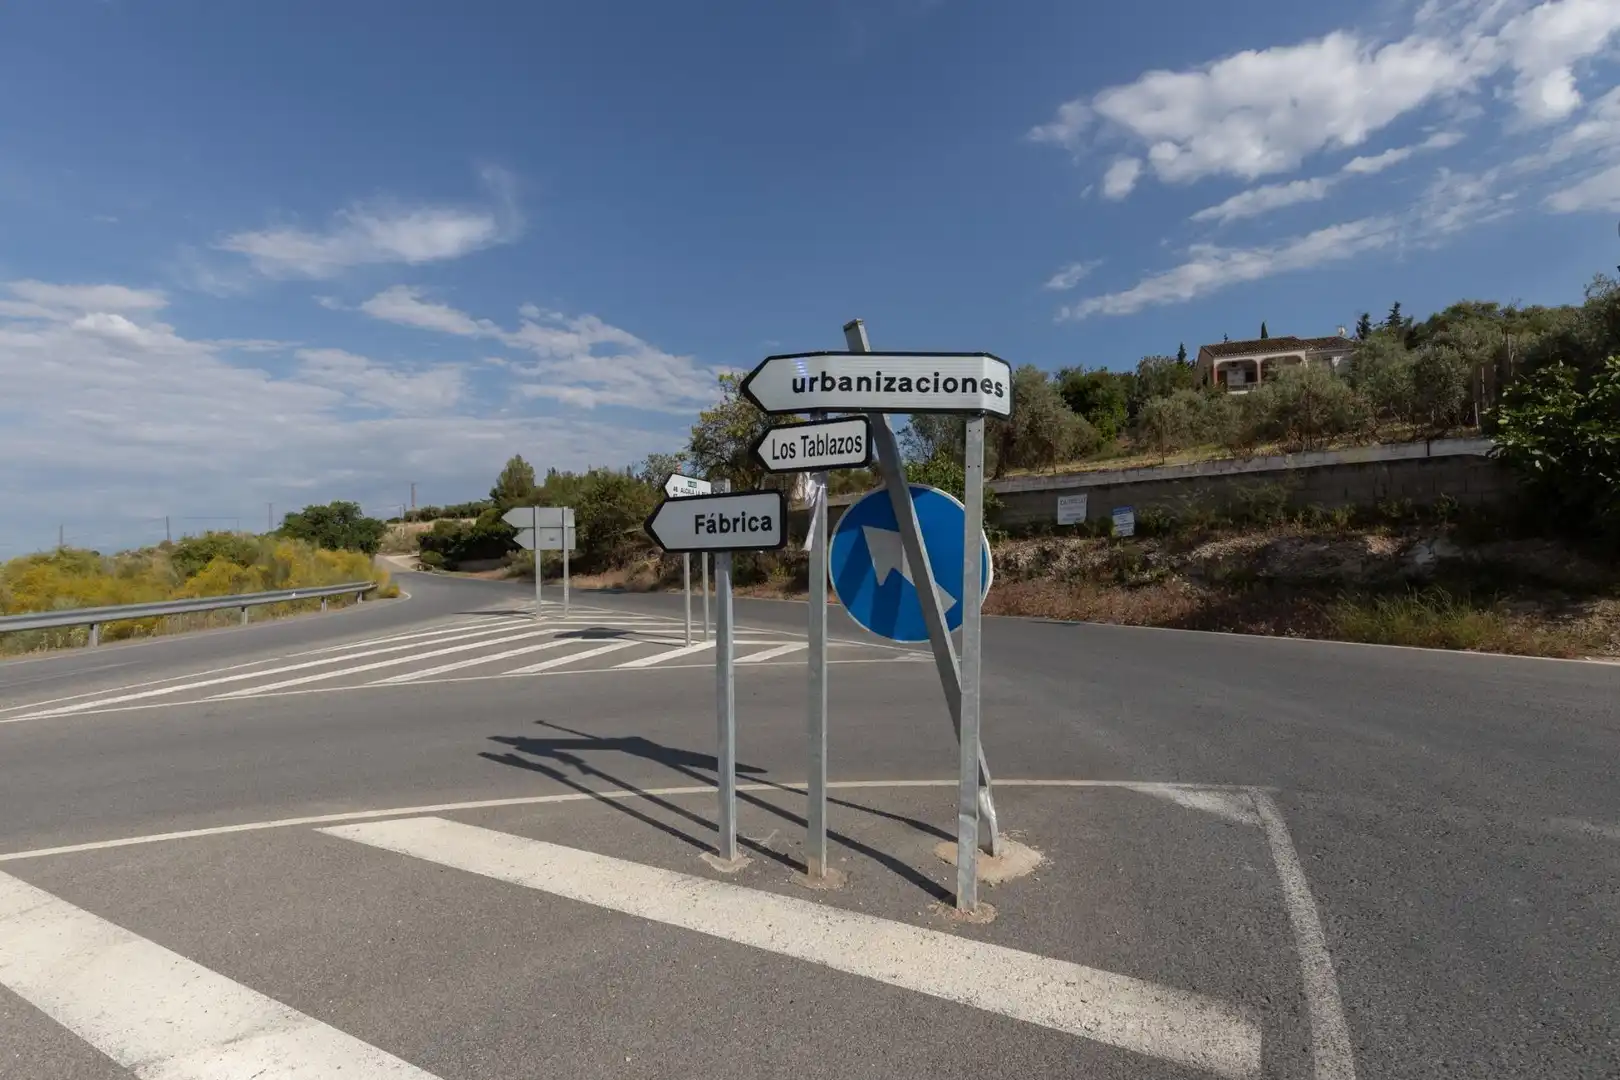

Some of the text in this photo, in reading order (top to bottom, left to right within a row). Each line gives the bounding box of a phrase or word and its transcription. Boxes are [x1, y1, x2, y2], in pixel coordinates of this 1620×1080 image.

[792, 371, 1004, 398] urbanizaciones
[772, 433, 862, 460] Los Tablazos
[694, 511, 772, 535] Fábrica
